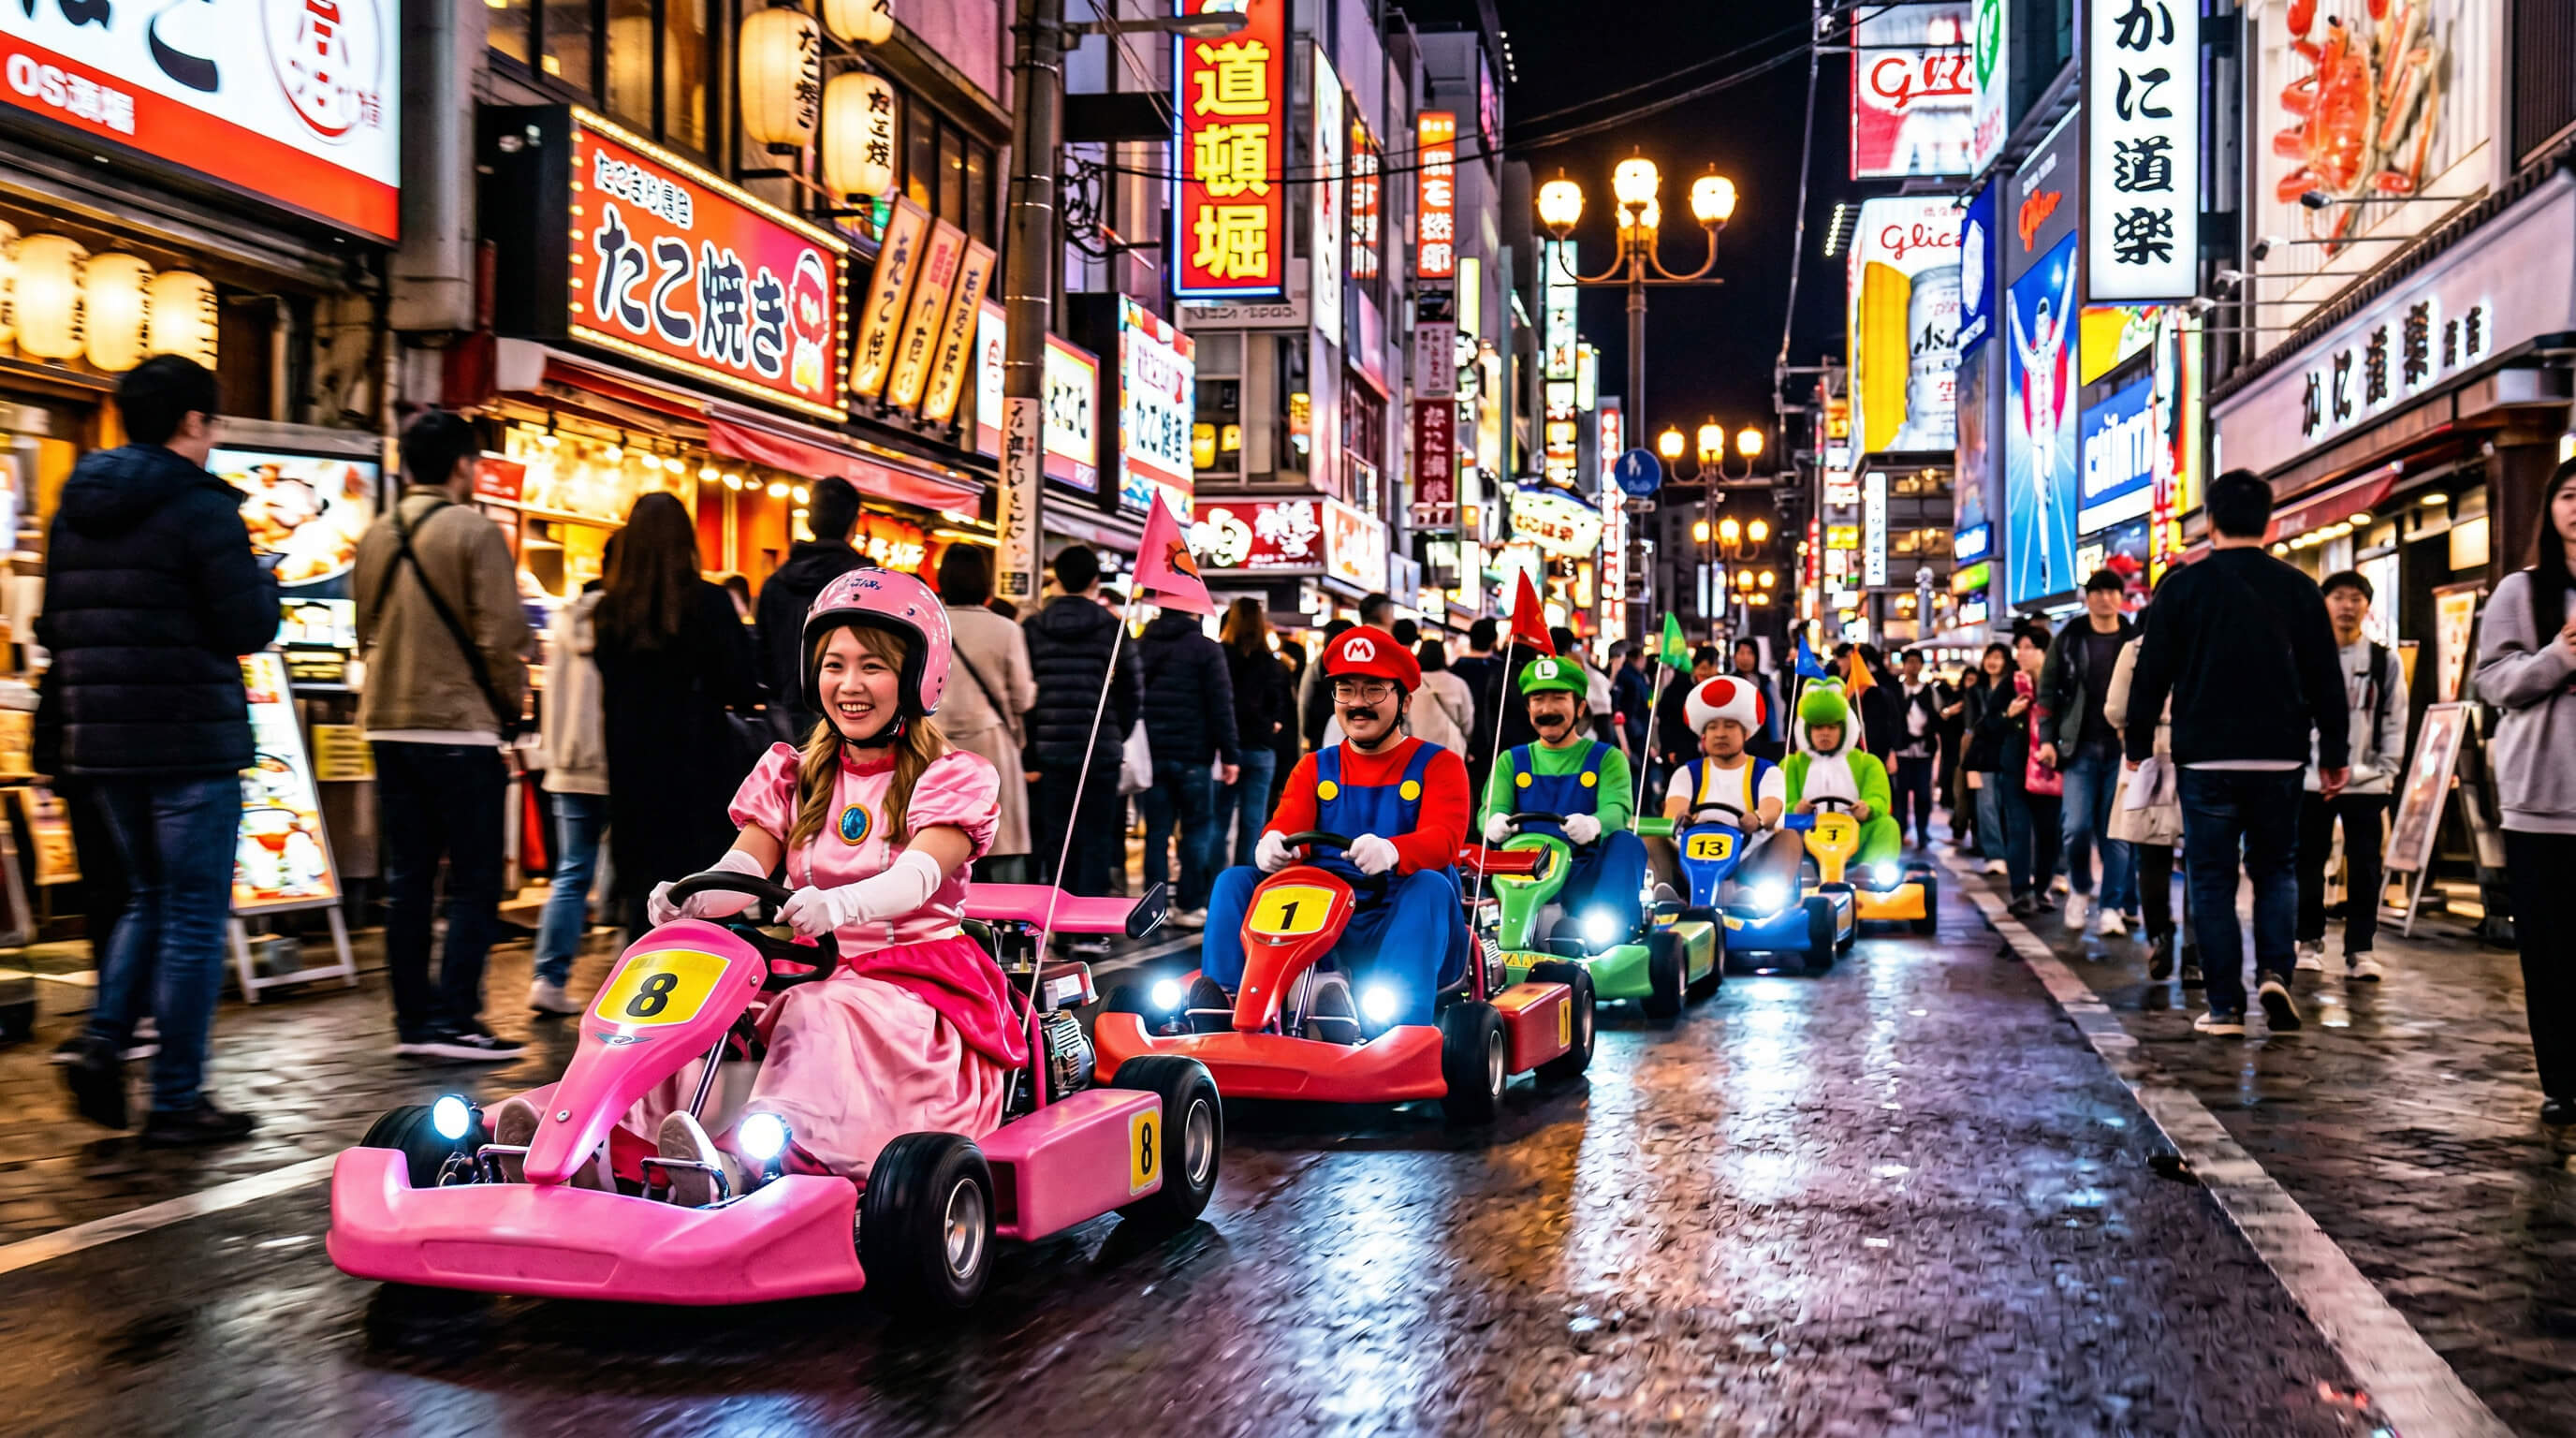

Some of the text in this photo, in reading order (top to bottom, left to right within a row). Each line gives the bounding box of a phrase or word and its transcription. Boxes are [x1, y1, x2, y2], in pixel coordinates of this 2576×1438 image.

[2114, 0, 2175, 265] かに道楽
[1193, 39, 1271, 280] 道頓堀
[597, 205, 786, 376] たこ焼き
[1348, 640, 1371, 659] M
[1541, 663, 1551, 677] L
[1695, 840, 1724, 857] 13
[1281, 901, 1300, 930] 1
[625, 972, 679, 1018] 8
[1140, 1122, 1153, 1176] 8
